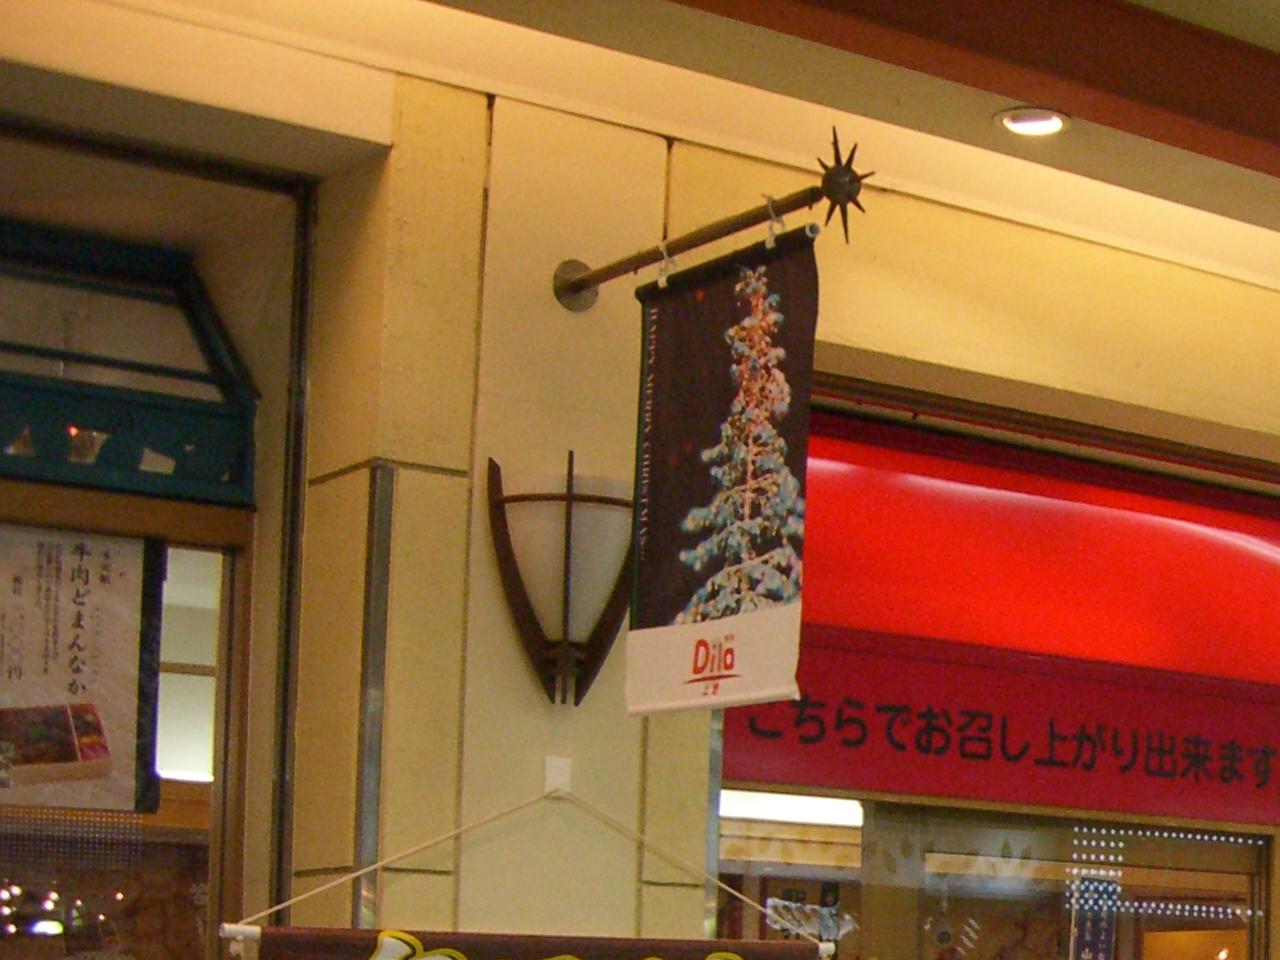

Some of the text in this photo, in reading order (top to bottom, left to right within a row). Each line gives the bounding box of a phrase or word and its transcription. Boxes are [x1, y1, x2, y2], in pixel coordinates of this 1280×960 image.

[747, 697, 1276, 789] こちらでお召し上がり出来ます
